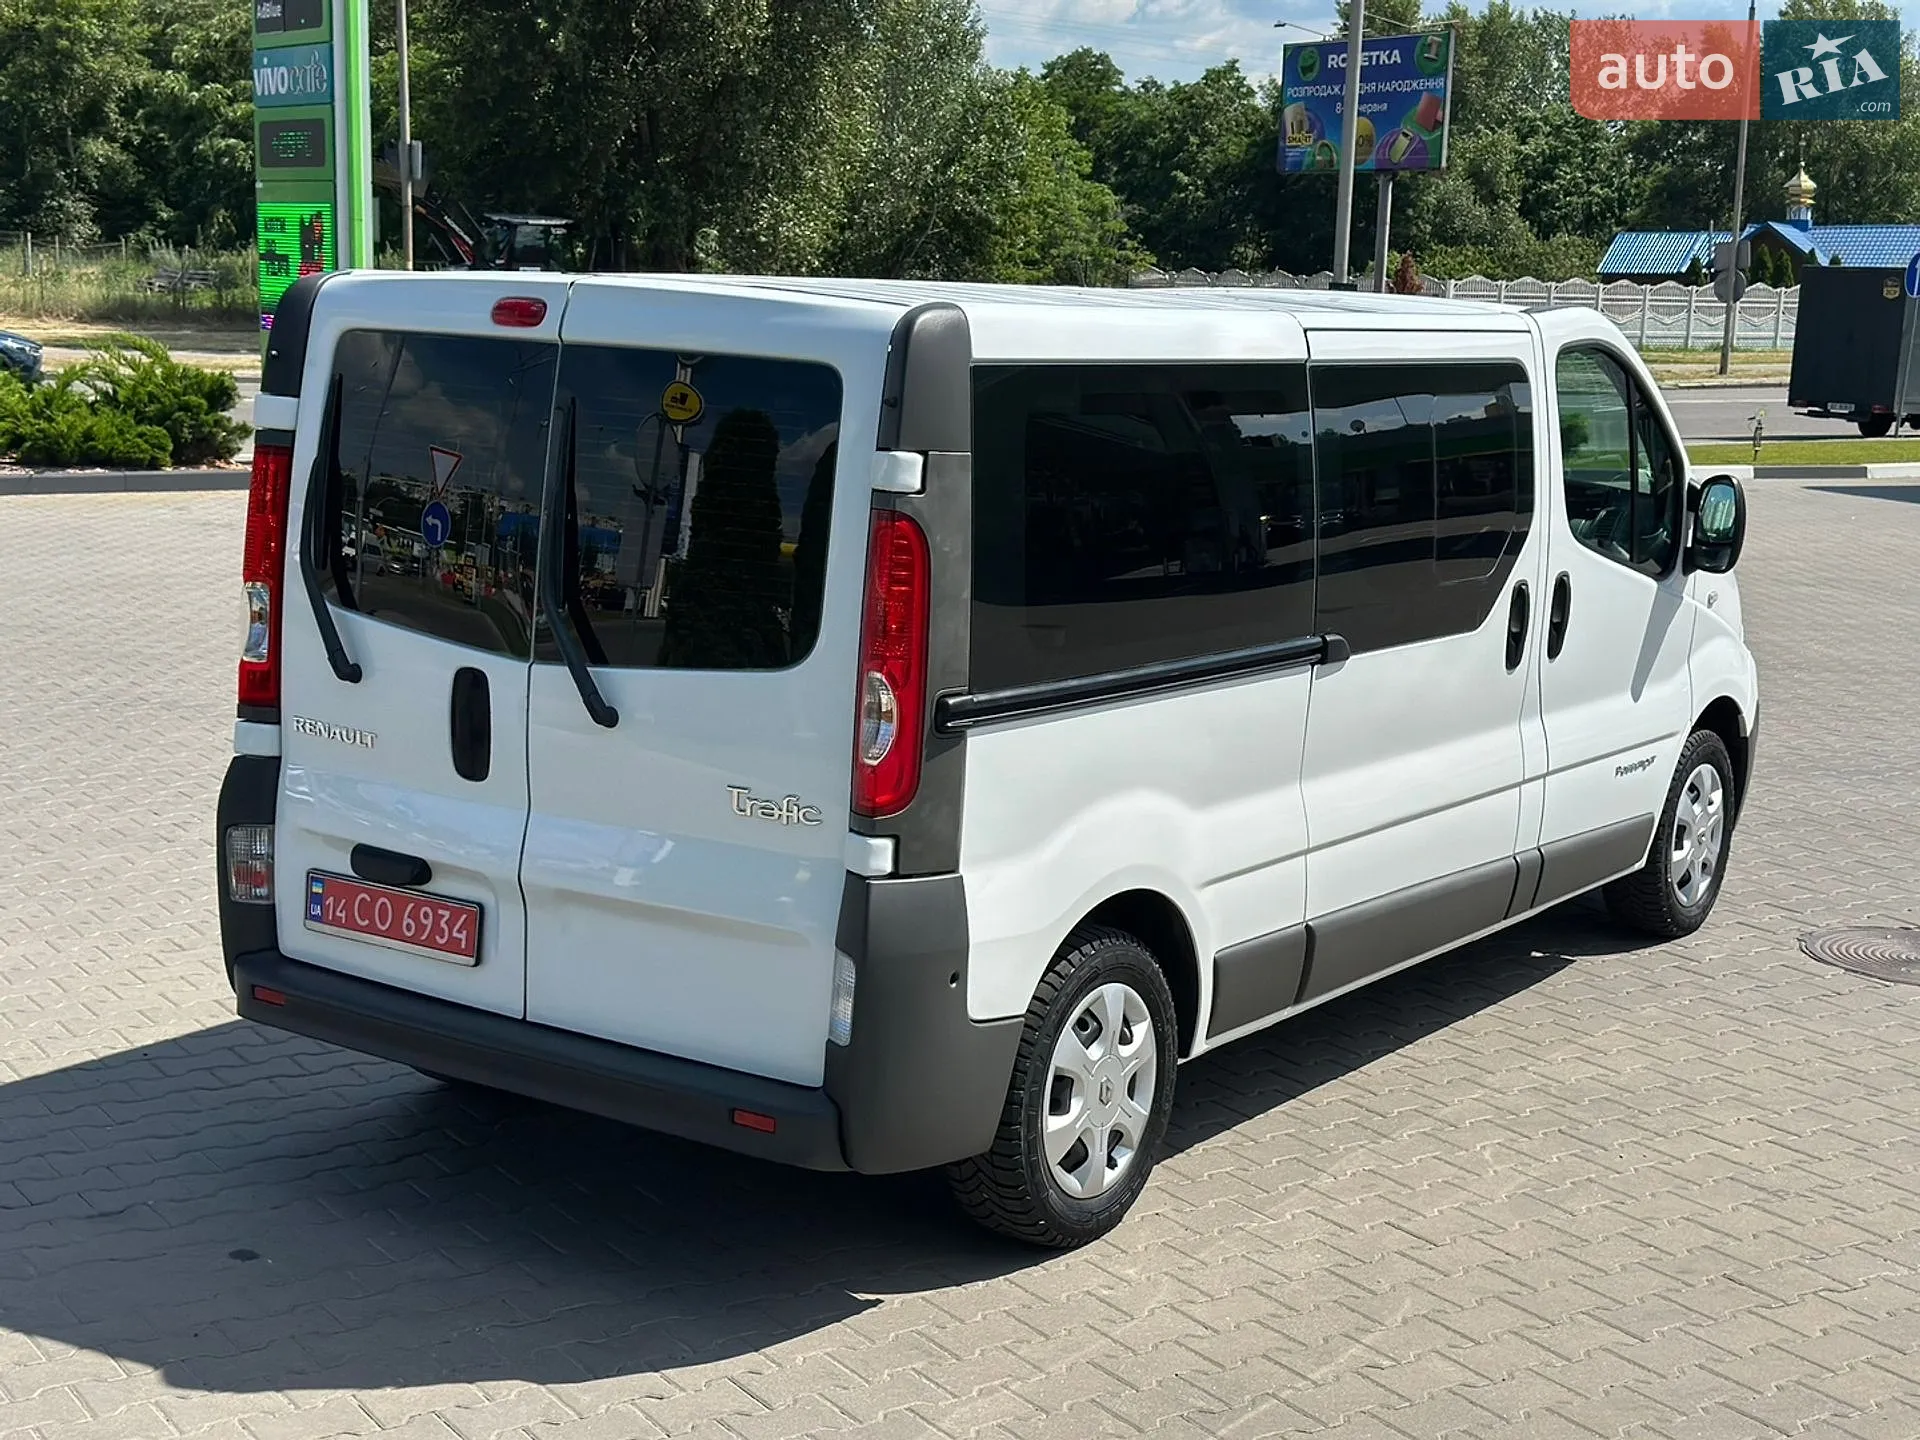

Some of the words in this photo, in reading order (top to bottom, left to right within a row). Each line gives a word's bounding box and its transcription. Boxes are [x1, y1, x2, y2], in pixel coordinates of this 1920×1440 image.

[1327, 49, 1401, 69] ROETKA
[1286, 84, 1341, 98] РОЗПРОДАЖ
[1377, 77, 1445, 93] НАРОДЖЕННЯ
[292, 715, 377, 749] RENAULT
[726, 784, 824, 826] Trafic
[310, 903, 322, 917] UA
[325, 896, 346, 924] 14
[354, 892, 393, 931] CO
[402, 902, 468, 949] 6934
